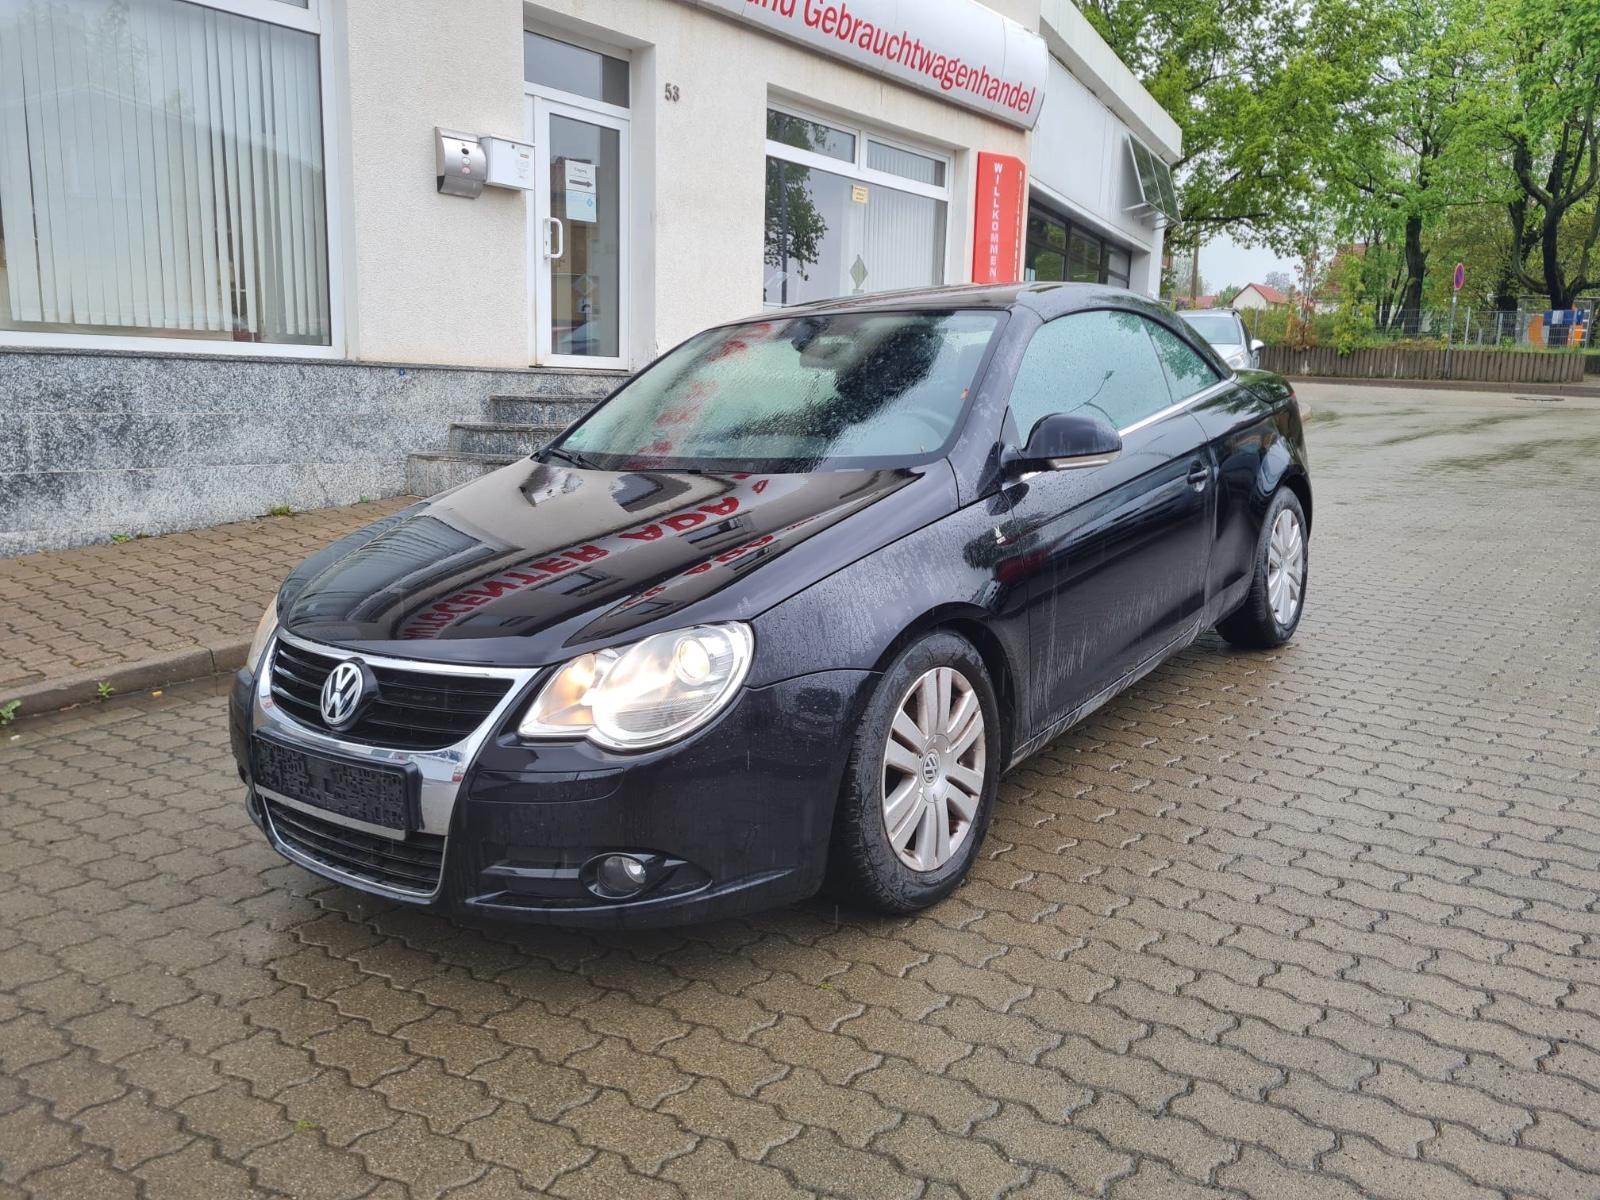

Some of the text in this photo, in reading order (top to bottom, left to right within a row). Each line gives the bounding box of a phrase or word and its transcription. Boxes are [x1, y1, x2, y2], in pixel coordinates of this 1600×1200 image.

[664, 82, 680, 102] 53
[804, 0, 1036, 115] Gebrauchtwagenhandel
[989, 162, 1003, 278] WILLKOMMEN
